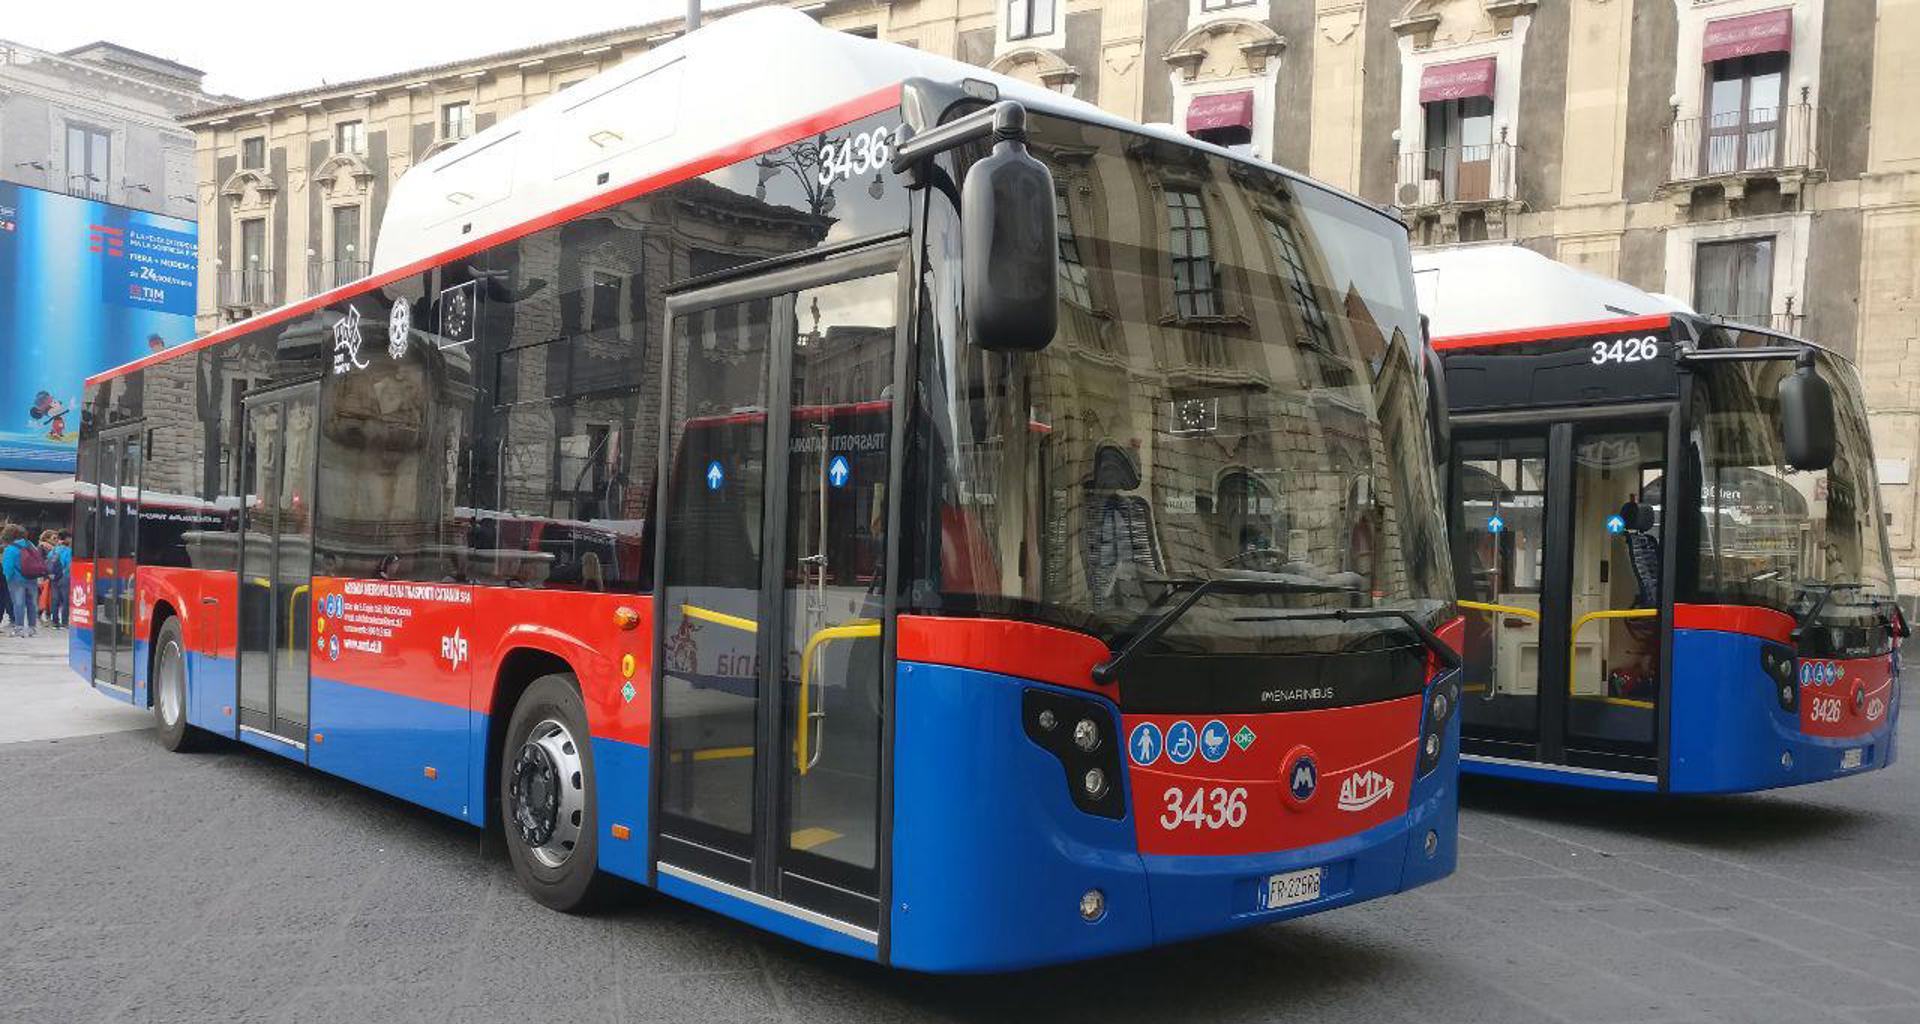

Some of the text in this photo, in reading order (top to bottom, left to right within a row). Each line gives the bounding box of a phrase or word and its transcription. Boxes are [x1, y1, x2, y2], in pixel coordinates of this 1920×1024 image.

[819, 125, 889, 185] 3436
[143, 287, 164, 299] TIM
[1591, 335, 1658, 365] 3426
[1811, 696, 1842, 723] 3426
[1339, 770, 1385, 803] AMT
[1160, 786, 1248, 831] 3436
